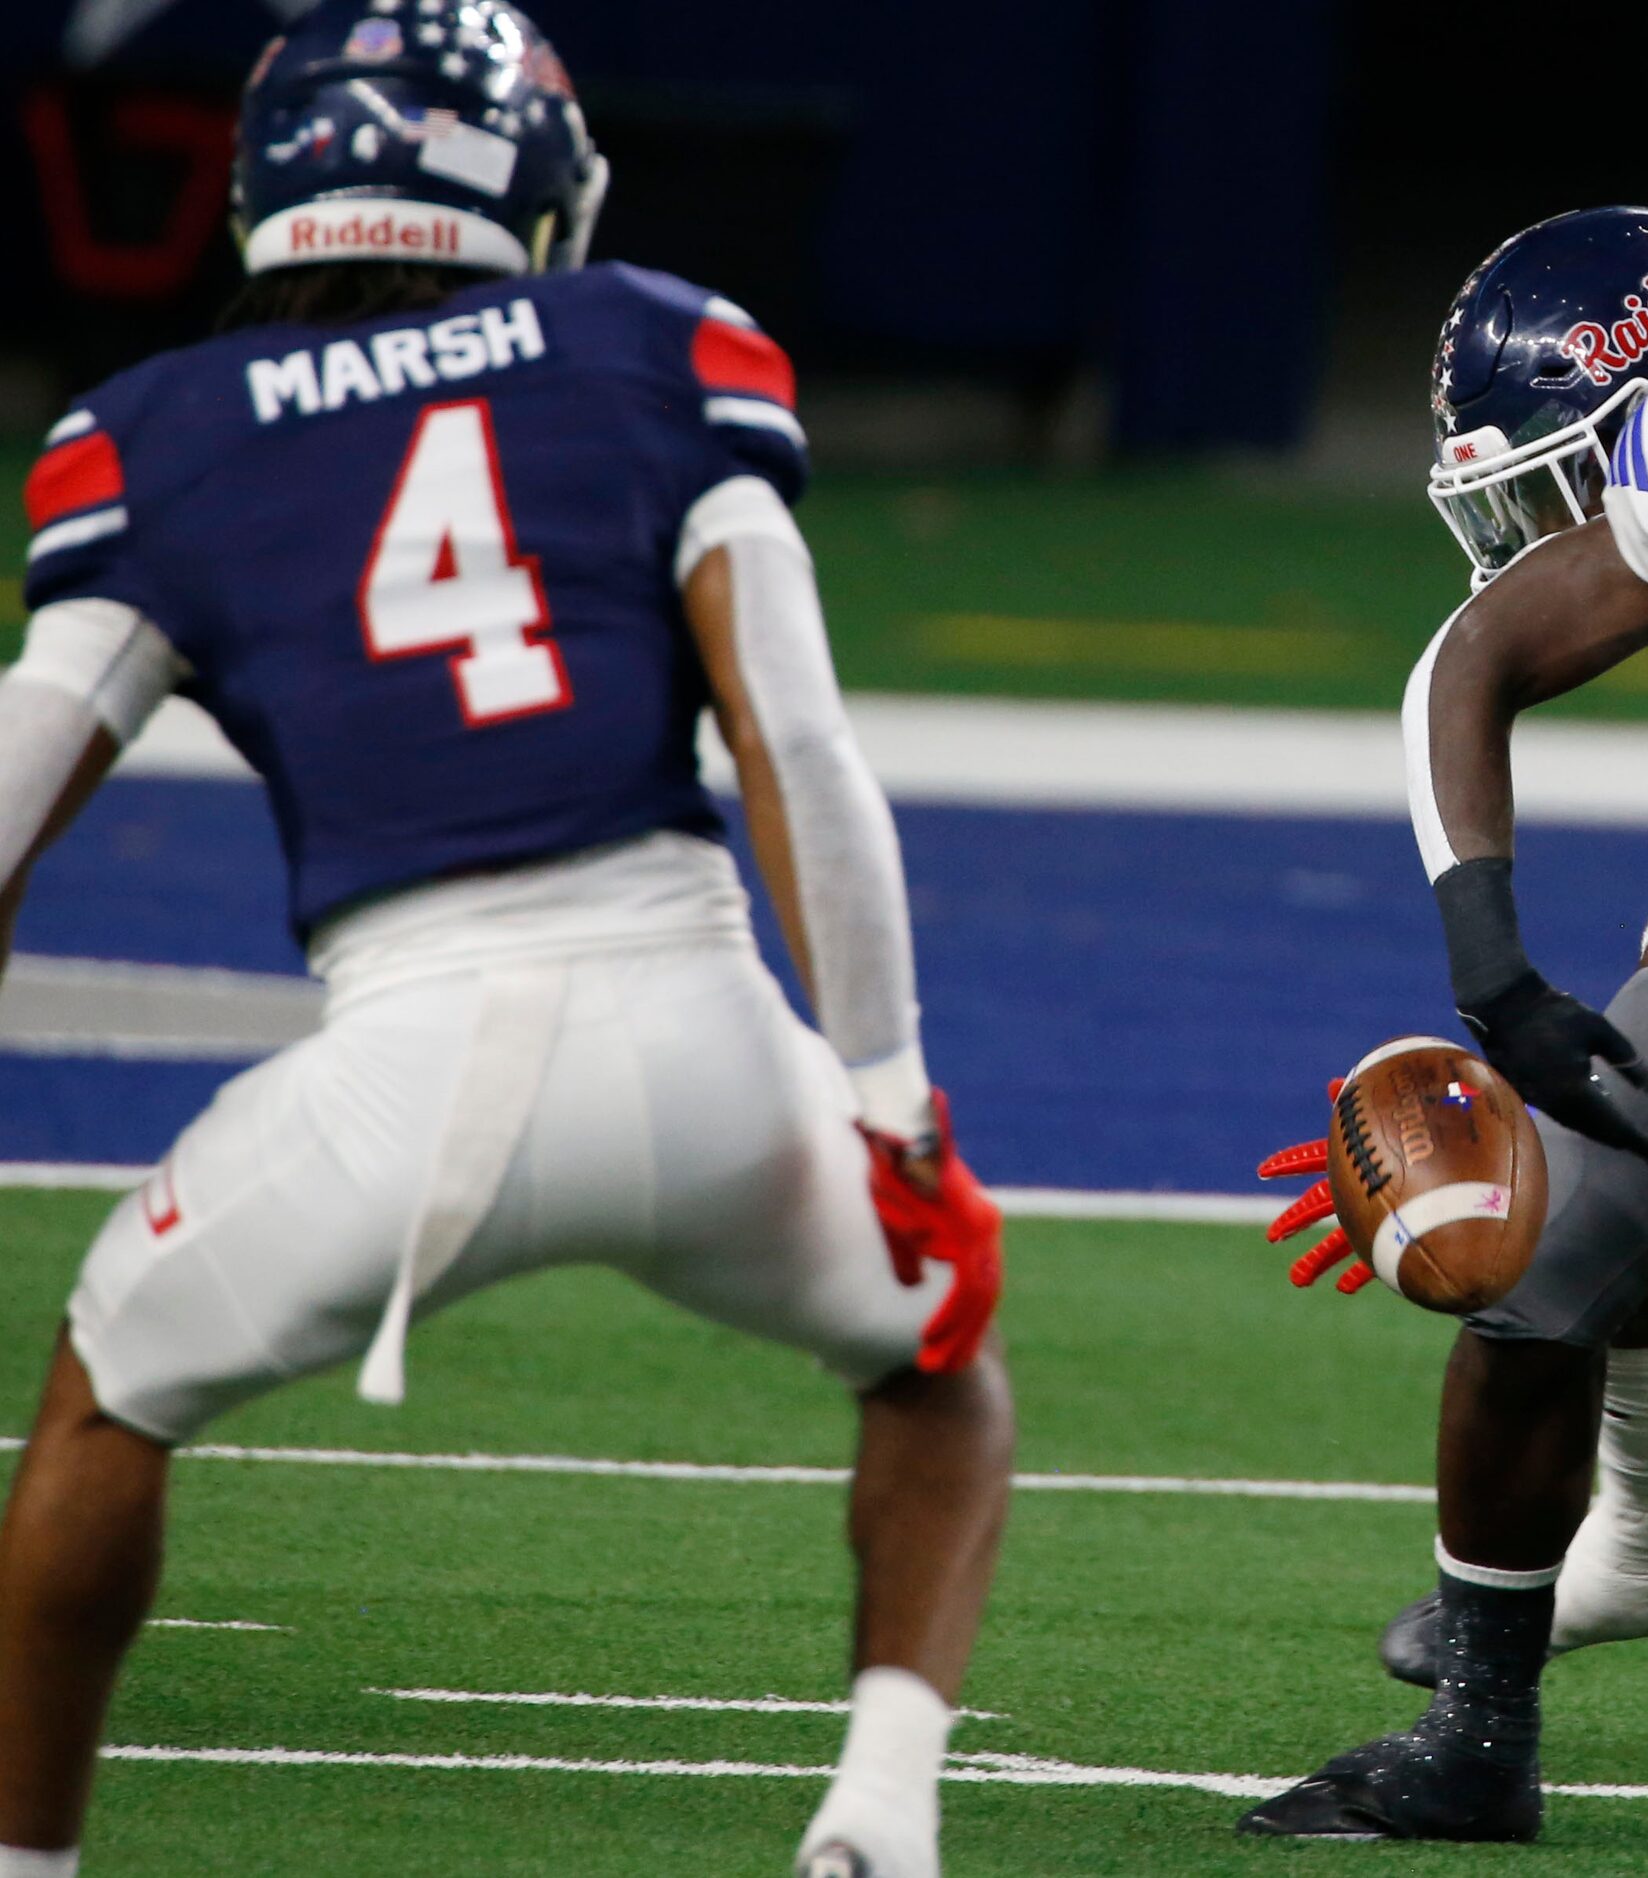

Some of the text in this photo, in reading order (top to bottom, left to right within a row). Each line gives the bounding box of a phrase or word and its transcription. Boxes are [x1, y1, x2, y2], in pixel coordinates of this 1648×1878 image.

[288, 215, 462, 256] Riddell
[247, 300, 546, 423] MARSH
[1452, 442, 1479, 463] ONE
[357, 398, 574, 728] 4
